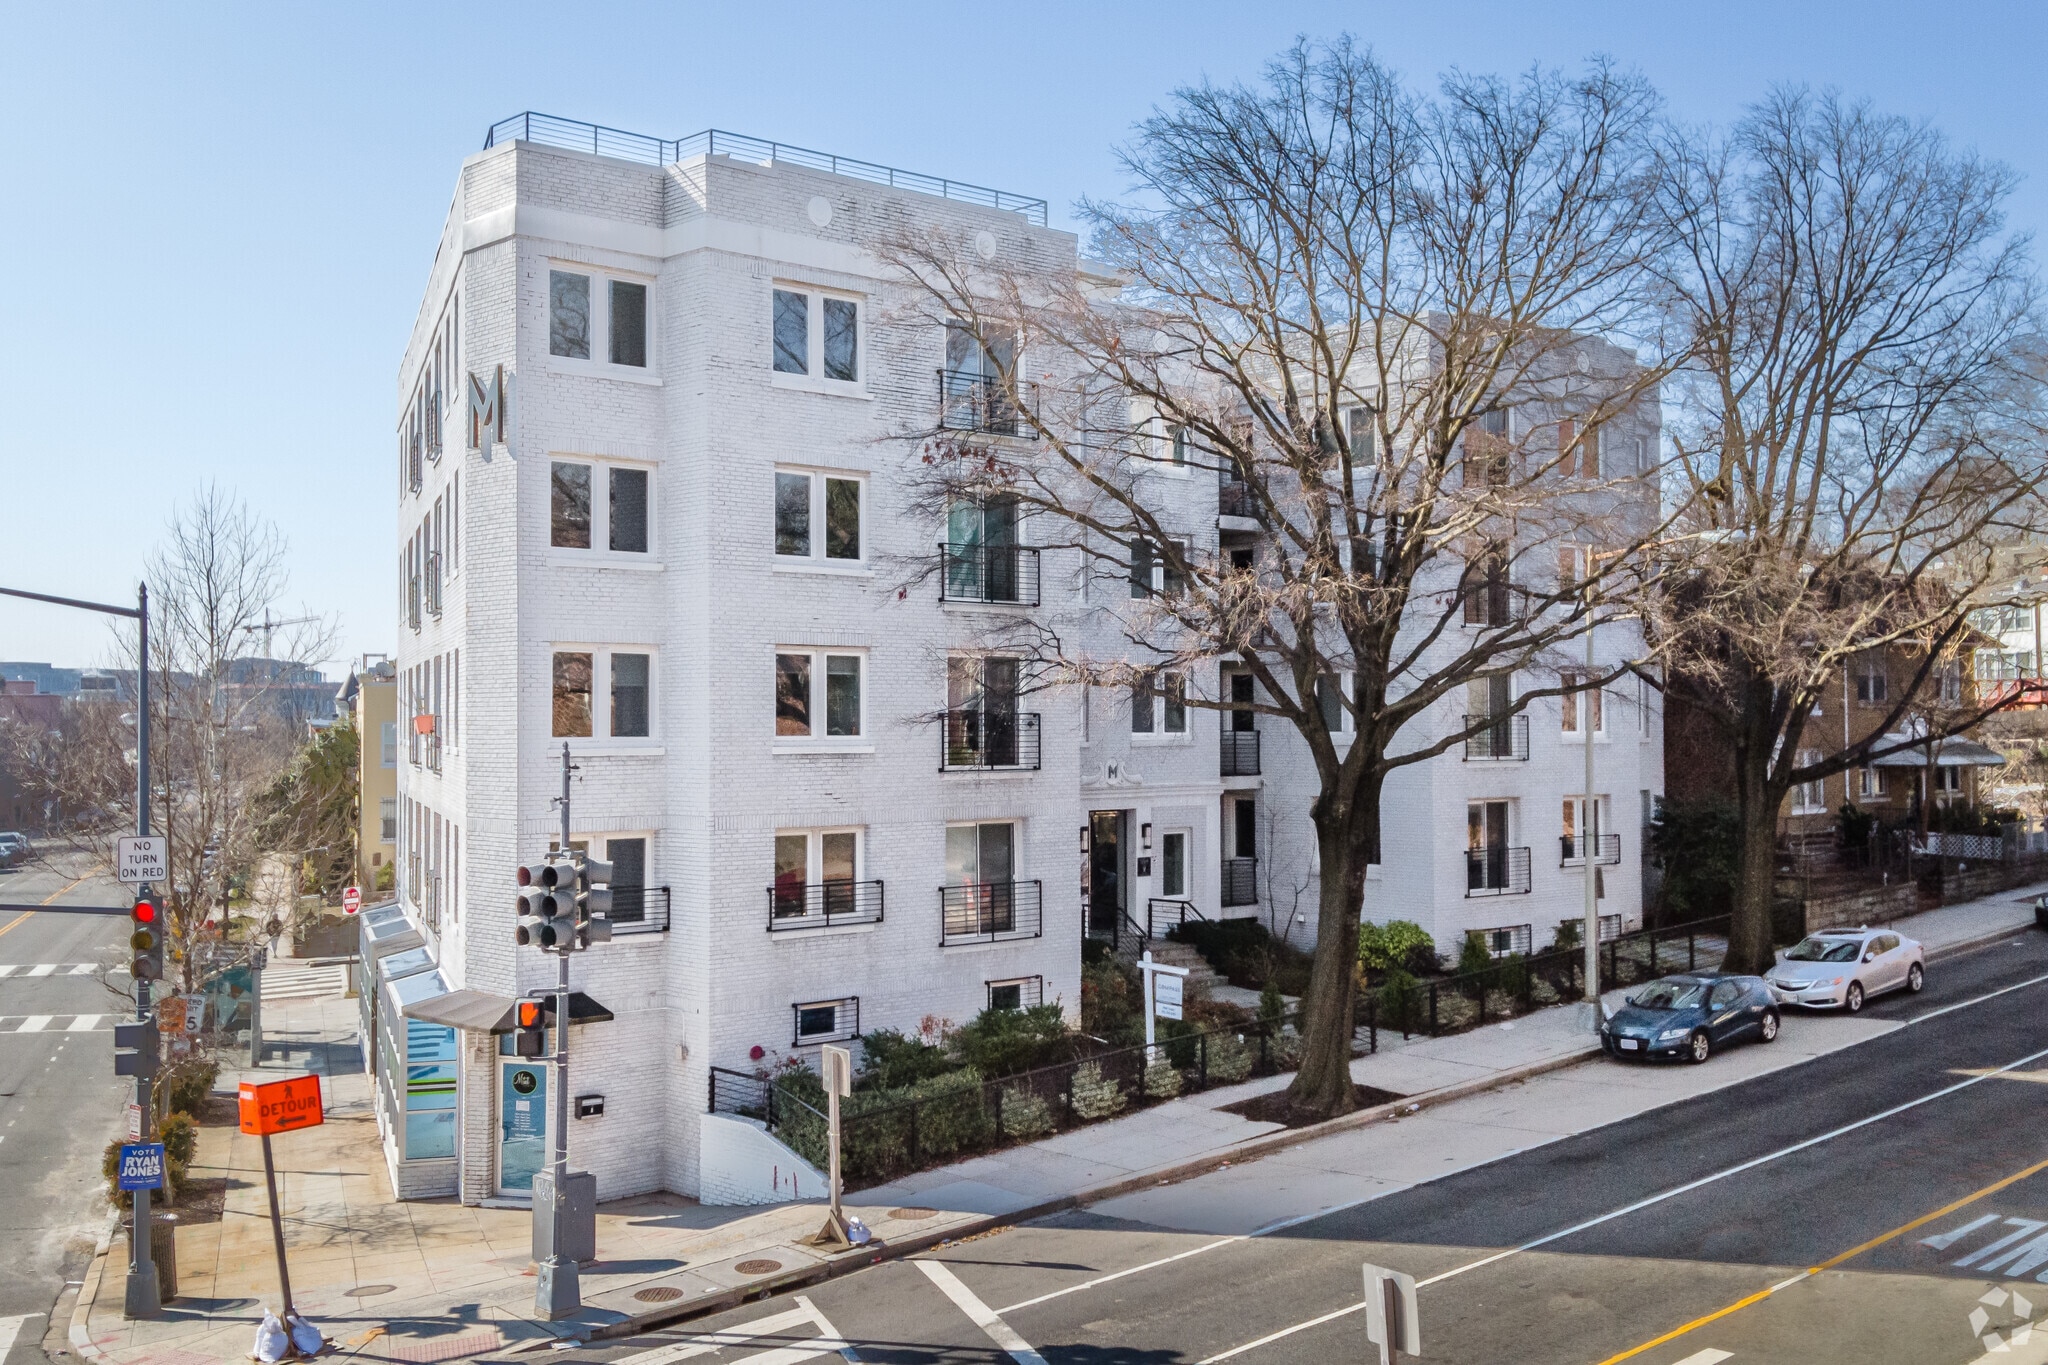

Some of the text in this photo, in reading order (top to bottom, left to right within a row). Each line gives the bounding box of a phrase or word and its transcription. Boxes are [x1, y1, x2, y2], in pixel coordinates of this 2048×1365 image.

[133, 841, 151, 851] NO
[128, 854, 157, 864] TURN
[122, 867, 164, 878] ON RED
[186, 1016, 197, 1029] 5
[260, 1096, 317, 1117] DETOUR
[132, 1148, 155, 1156] VOTE
[125, 1155, 159, 1167] RYAN
[121, 1165, 161, 1177] JONES
